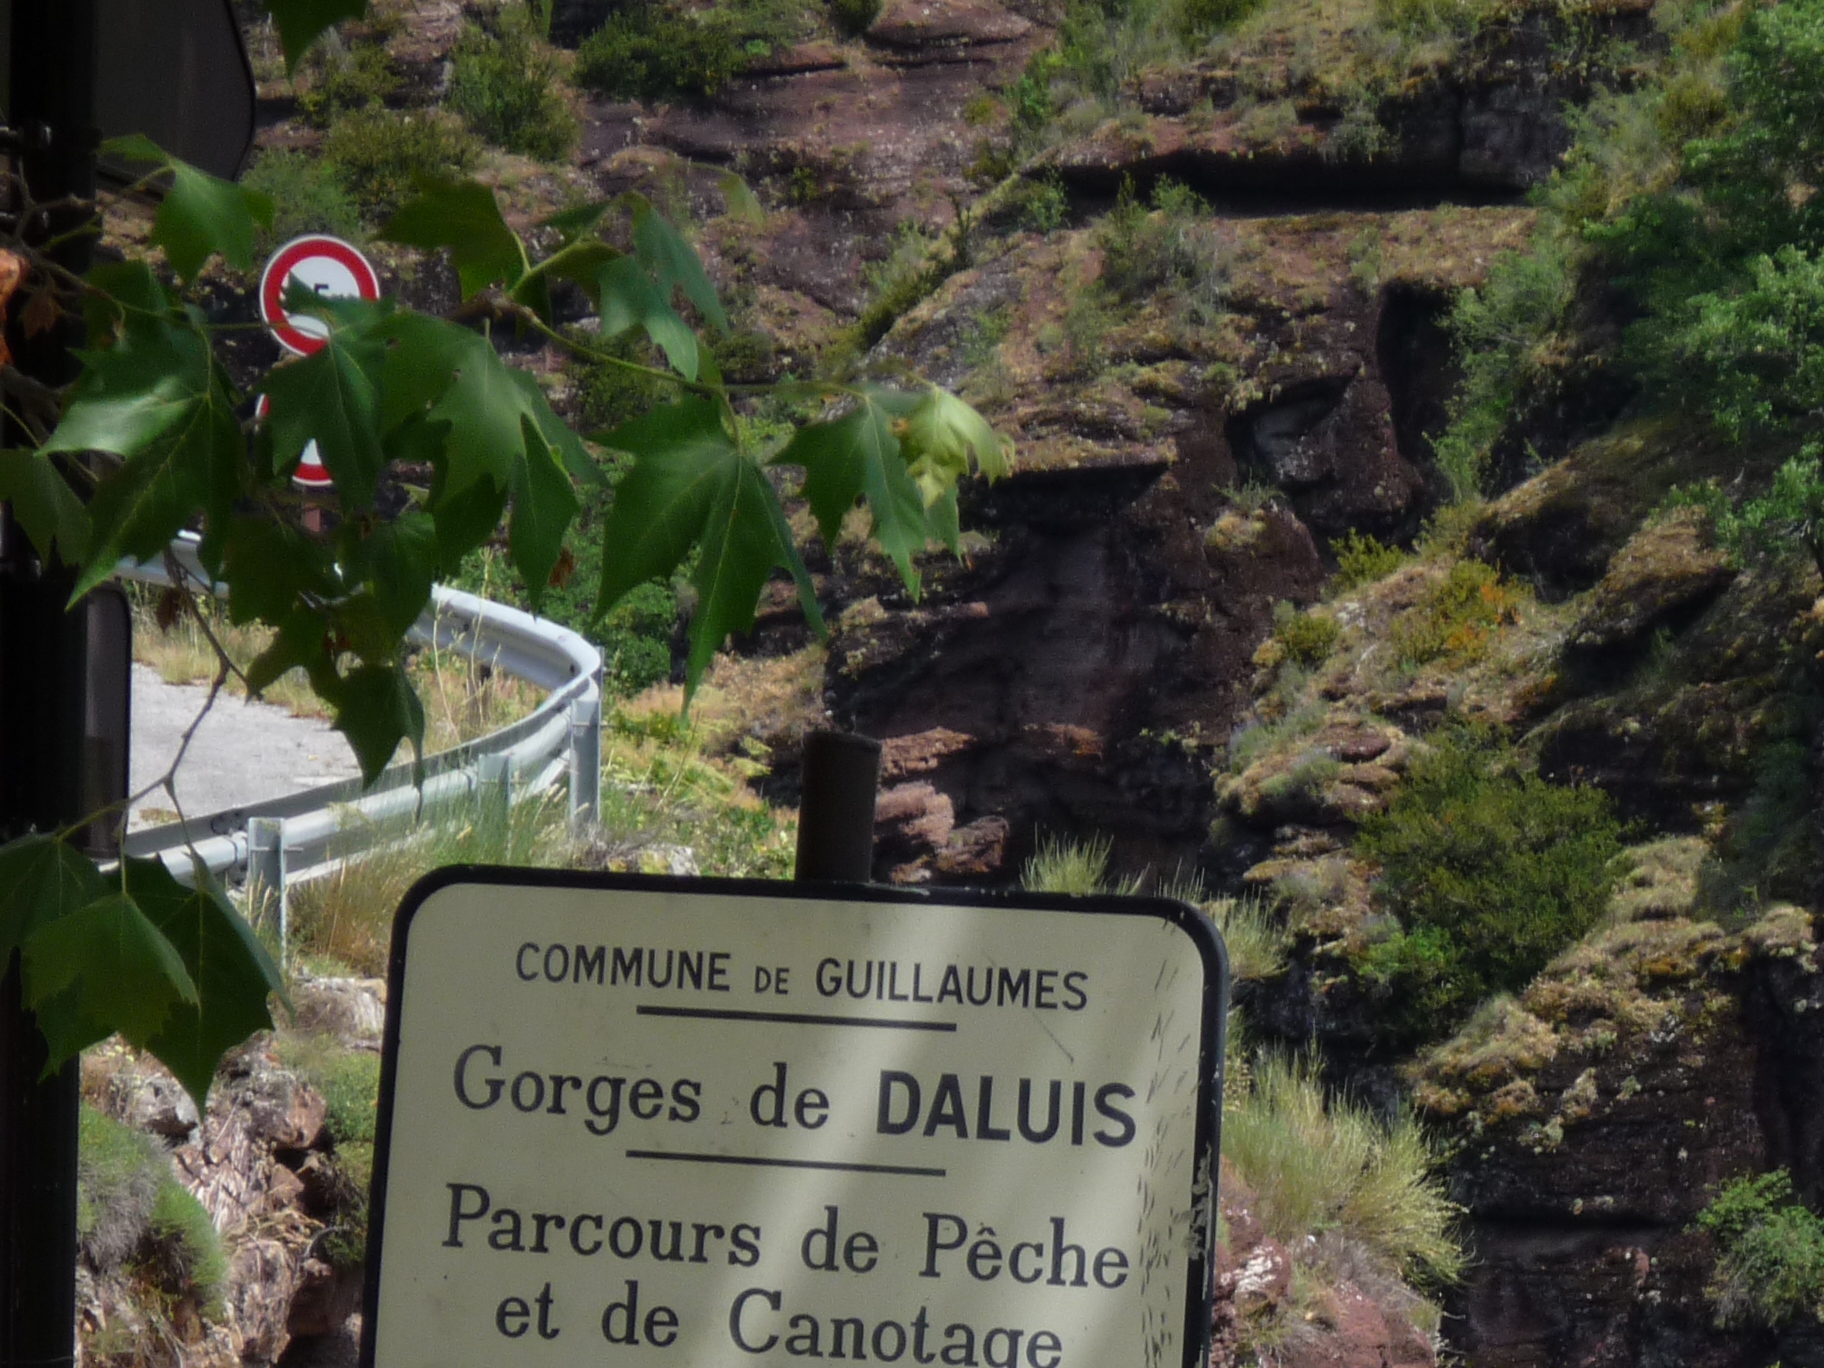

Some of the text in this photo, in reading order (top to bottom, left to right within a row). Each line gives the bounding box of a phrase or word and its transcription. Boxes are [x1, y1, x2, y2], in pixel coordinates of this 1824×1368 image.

[516, 943, 1088, 1011] COMMUNE DE GUILLAUMES
[454, 1045, 1135, 1147] Gorges de DALUIS
[442, 1183, 1128, 1288] Parcours de Pêche
[496, 1282, 560, 1340] et
[602, 1280, 679, 1347] de
